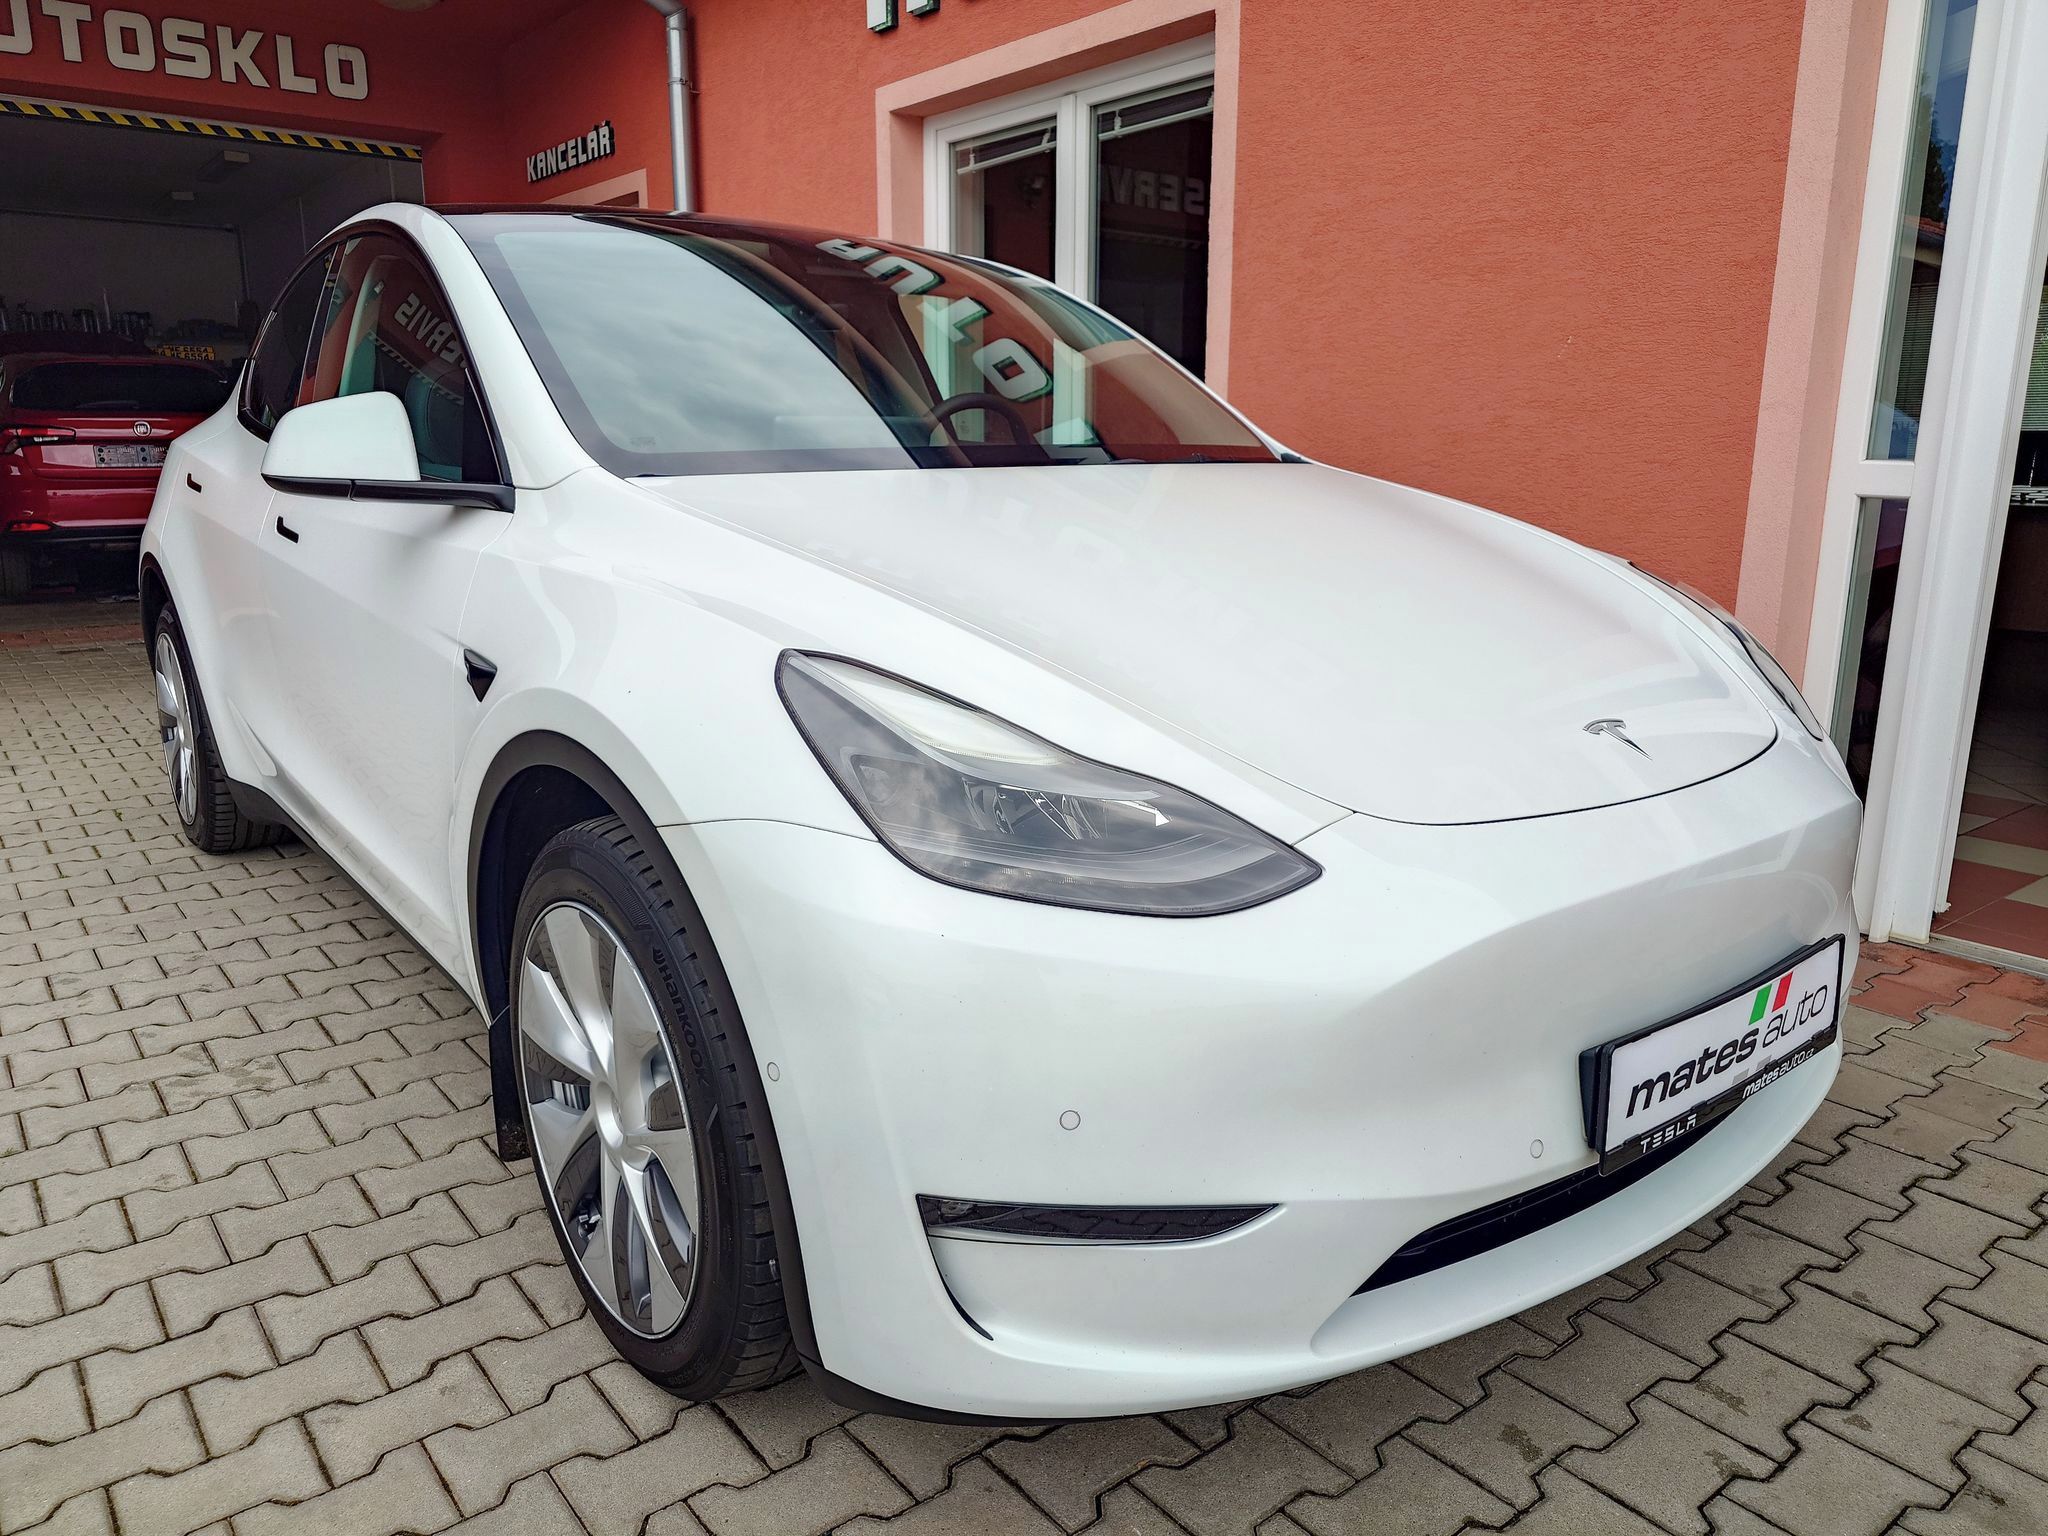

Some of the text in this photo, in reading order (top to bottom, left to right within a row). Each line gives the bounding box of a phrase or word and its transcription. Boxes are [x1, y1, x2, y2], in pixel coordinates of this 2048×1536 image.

[1626, 984, 1828, 1119] mates auto
[1640, 1113, 1697, 1154] TESLA
